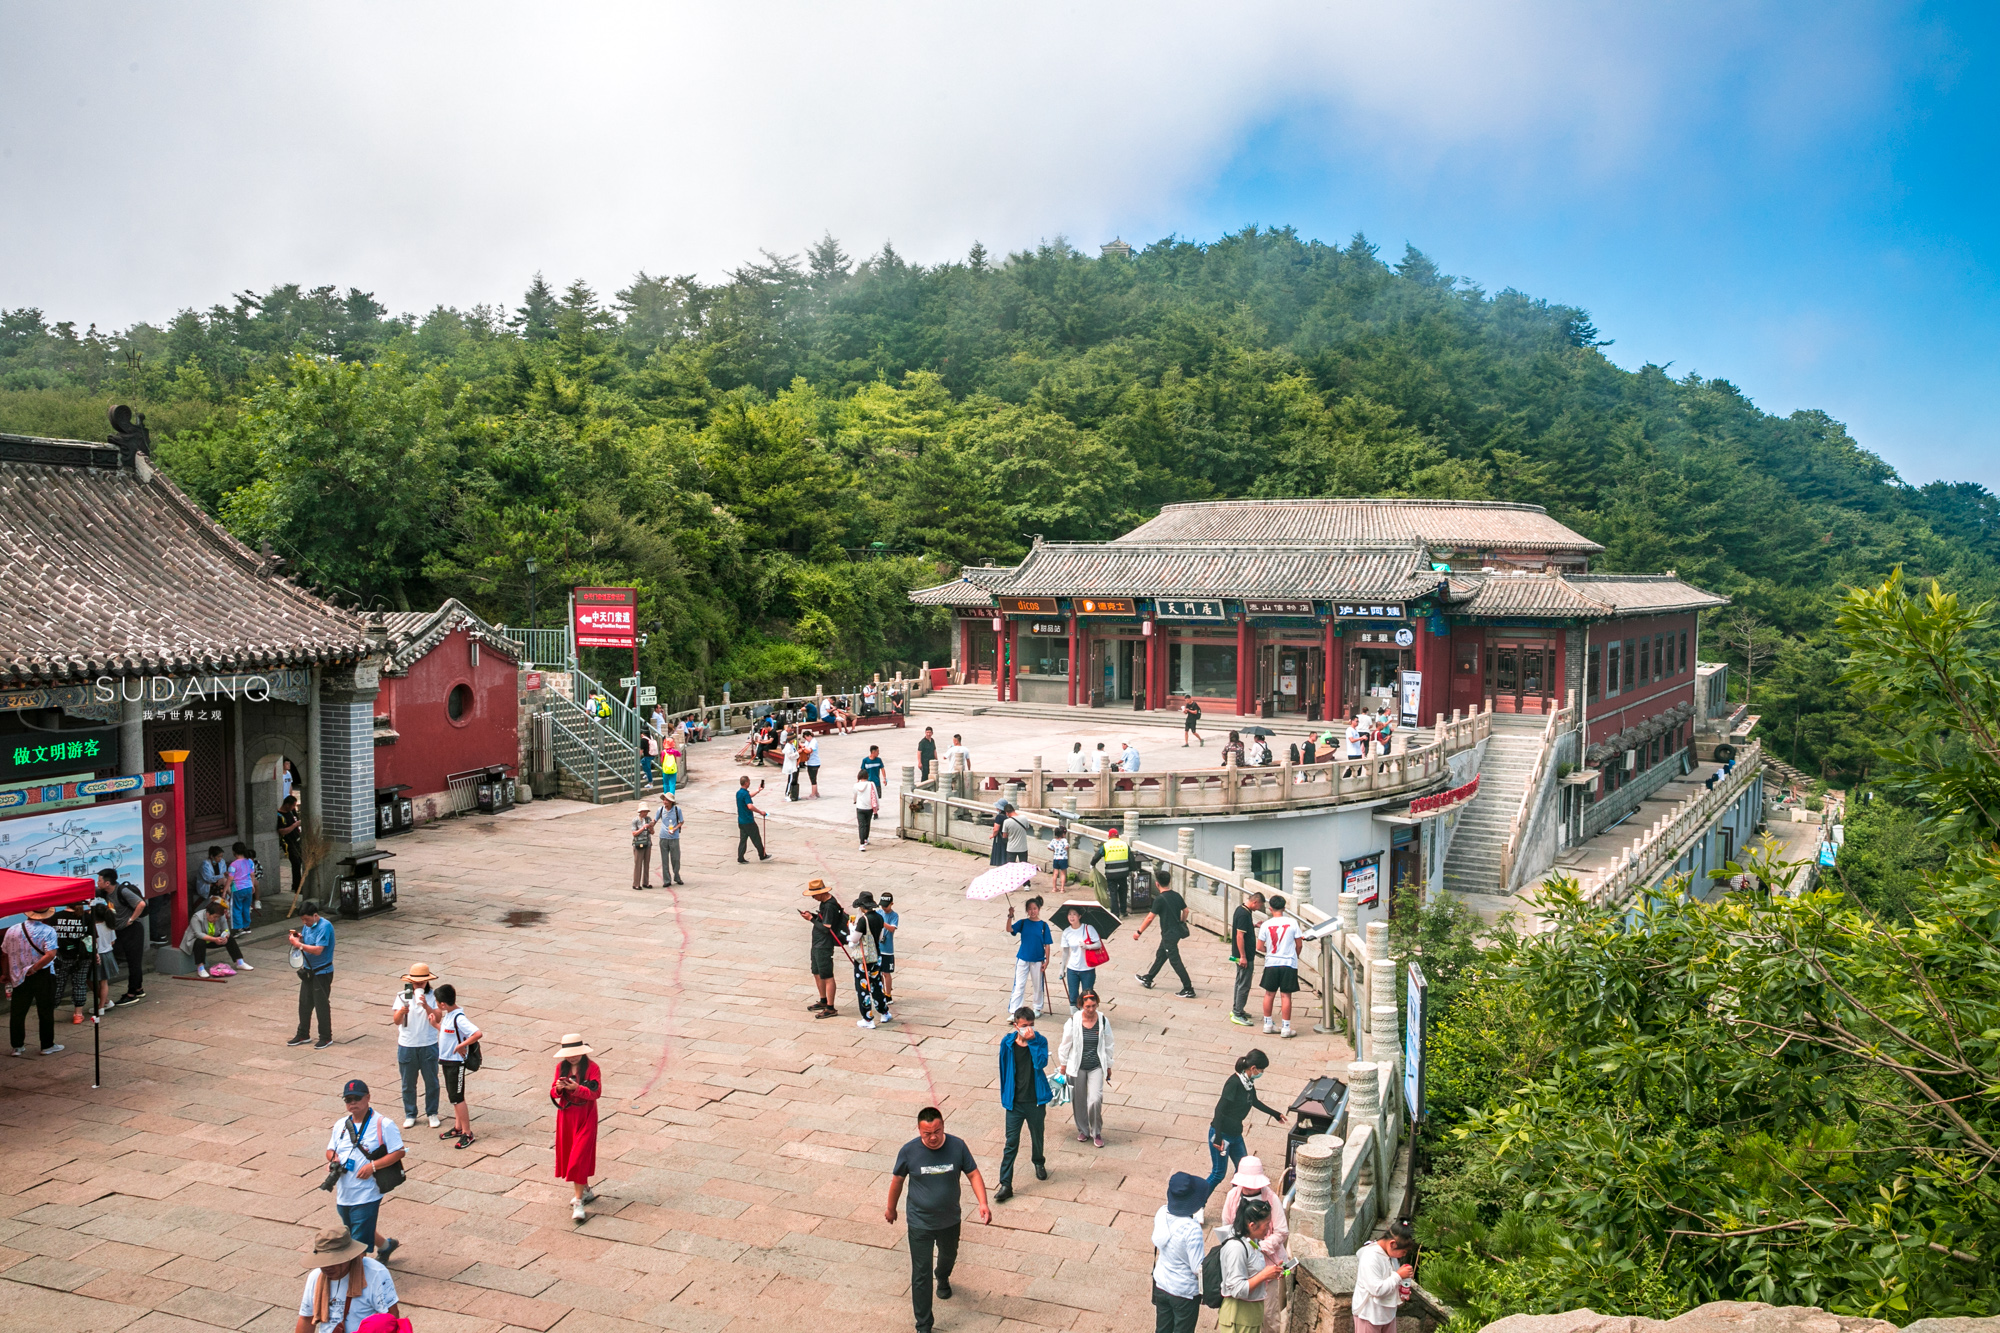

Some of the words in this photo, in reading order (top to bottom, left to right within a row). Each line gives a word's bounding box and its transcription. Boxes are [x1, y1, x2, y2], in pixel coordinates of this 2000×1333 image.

[1017, 601, 1040, 611] dicos
[1097, 602, 1125, 611] 德克士
[1339, 605, 1400, 616] 沪上阿姨
[592, 611, 630, 623] 中天门索道
[13, 738, 100, 766] 做文明游客
